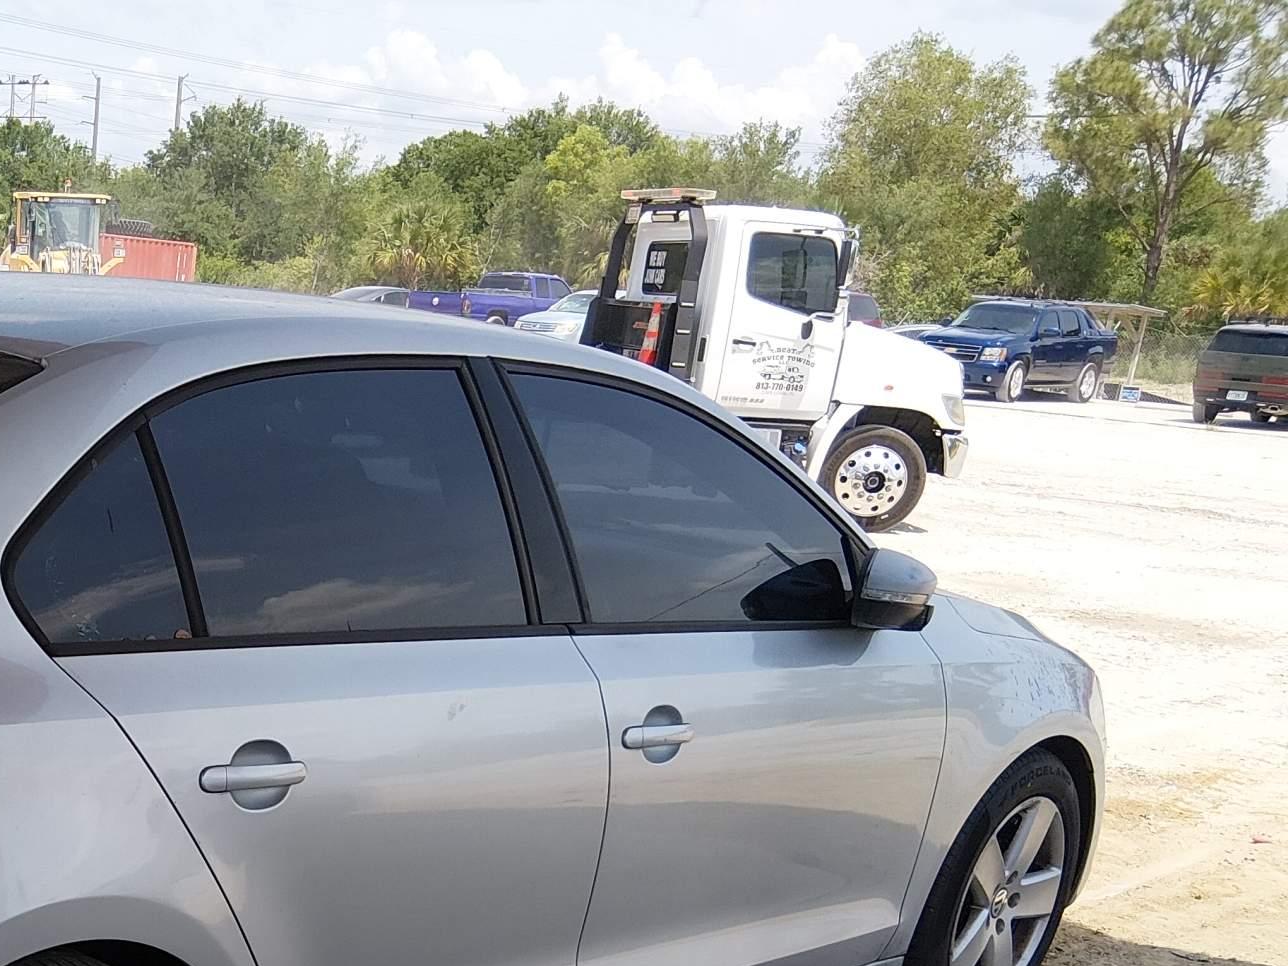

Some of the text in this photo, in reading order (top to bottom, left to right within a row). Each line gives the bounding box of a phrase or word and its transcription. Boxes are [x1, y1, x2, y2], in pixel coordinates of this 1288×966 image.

[752, 354, 815, 368] SERVICE TOWING
[755, 382, 804, 392] 813-770-0149
